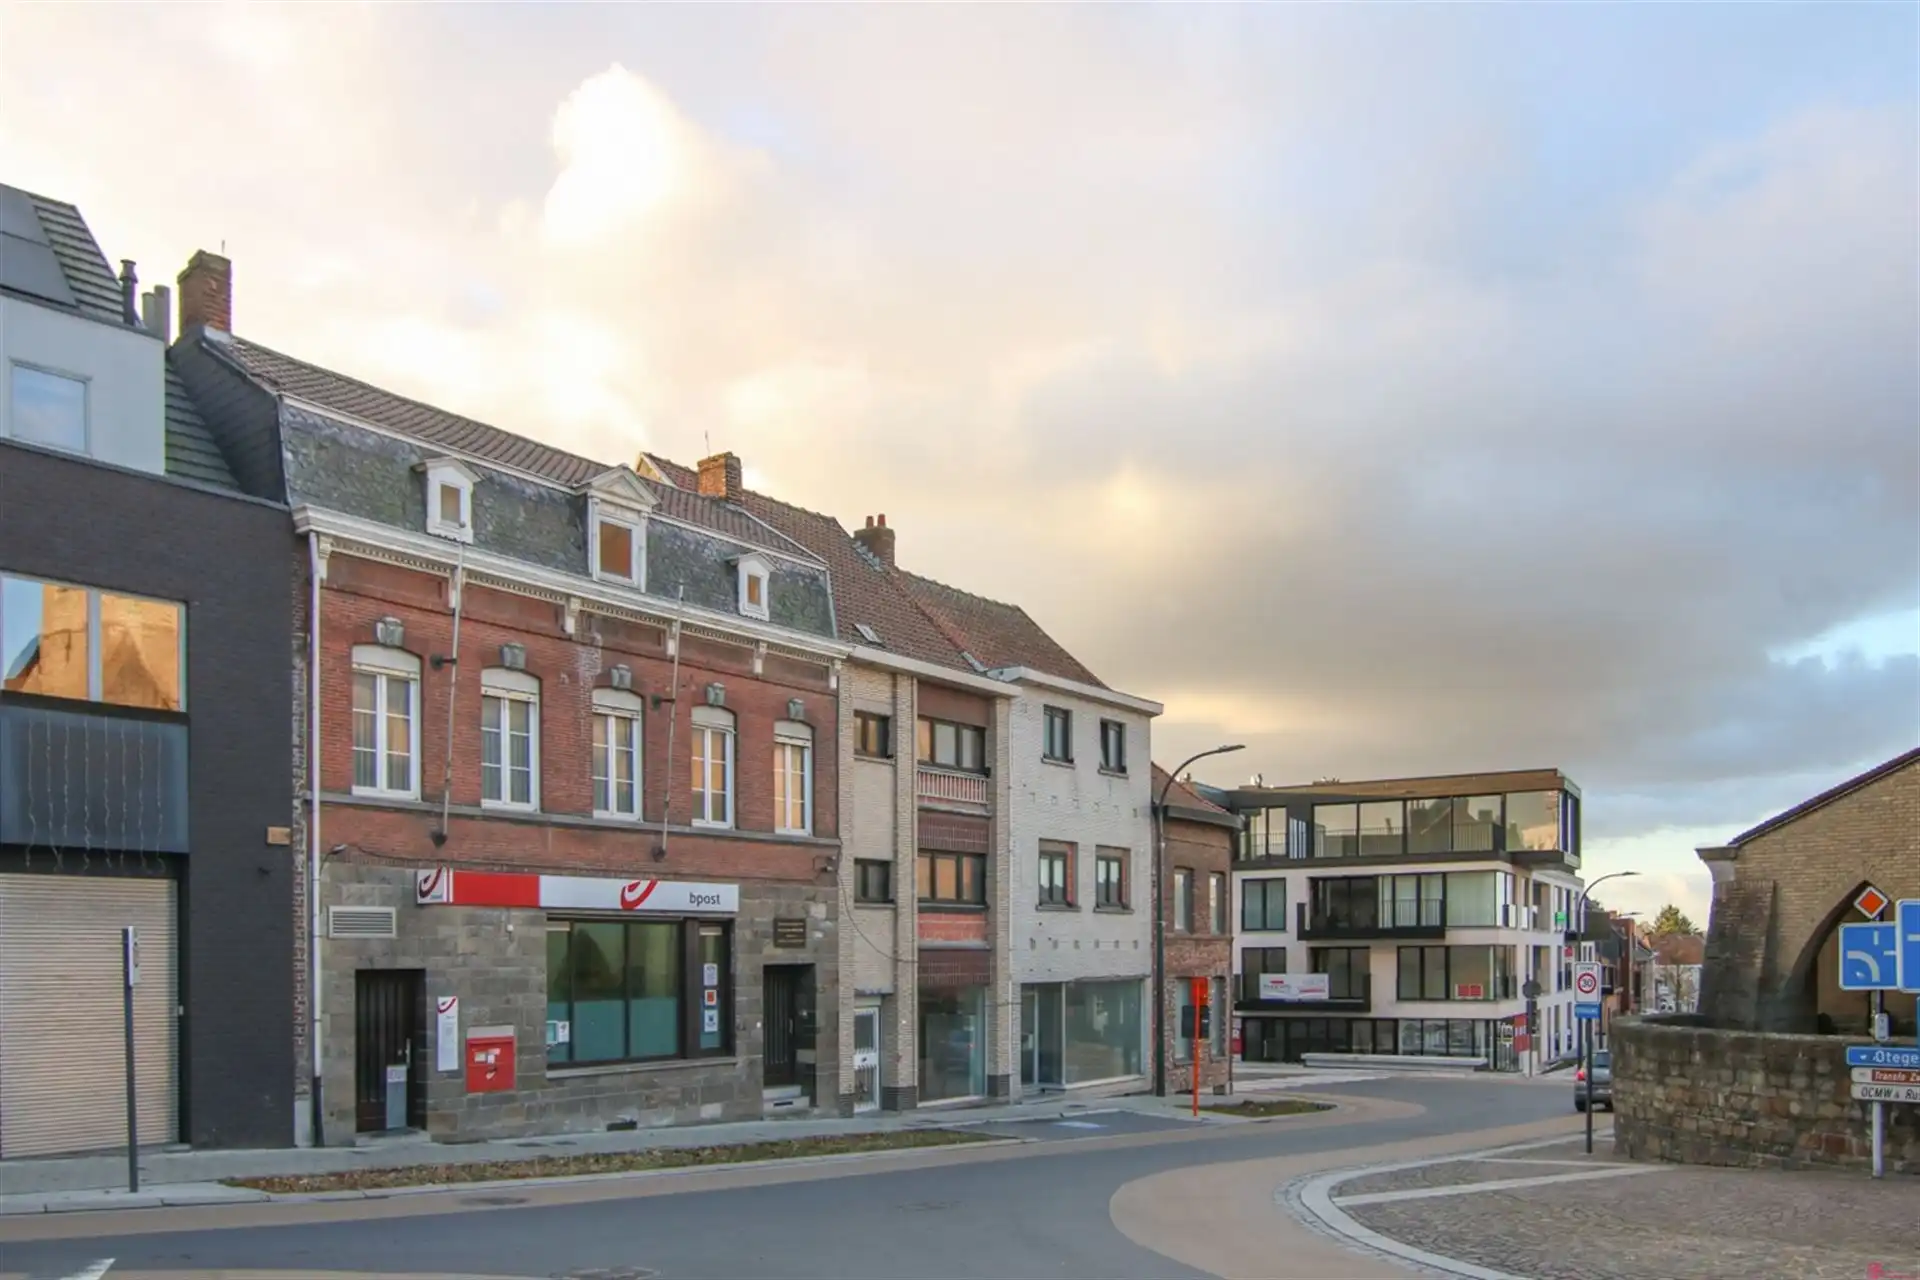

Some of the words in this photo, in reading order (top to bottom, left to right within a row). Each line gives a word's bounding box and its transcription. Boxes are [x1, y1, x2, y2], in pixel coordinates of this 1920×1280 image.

[689, 892, 720, 907] bpost
[1581, 978, 1593, 989] 30
[1861, 1086, 1892, 1098] OCMW
